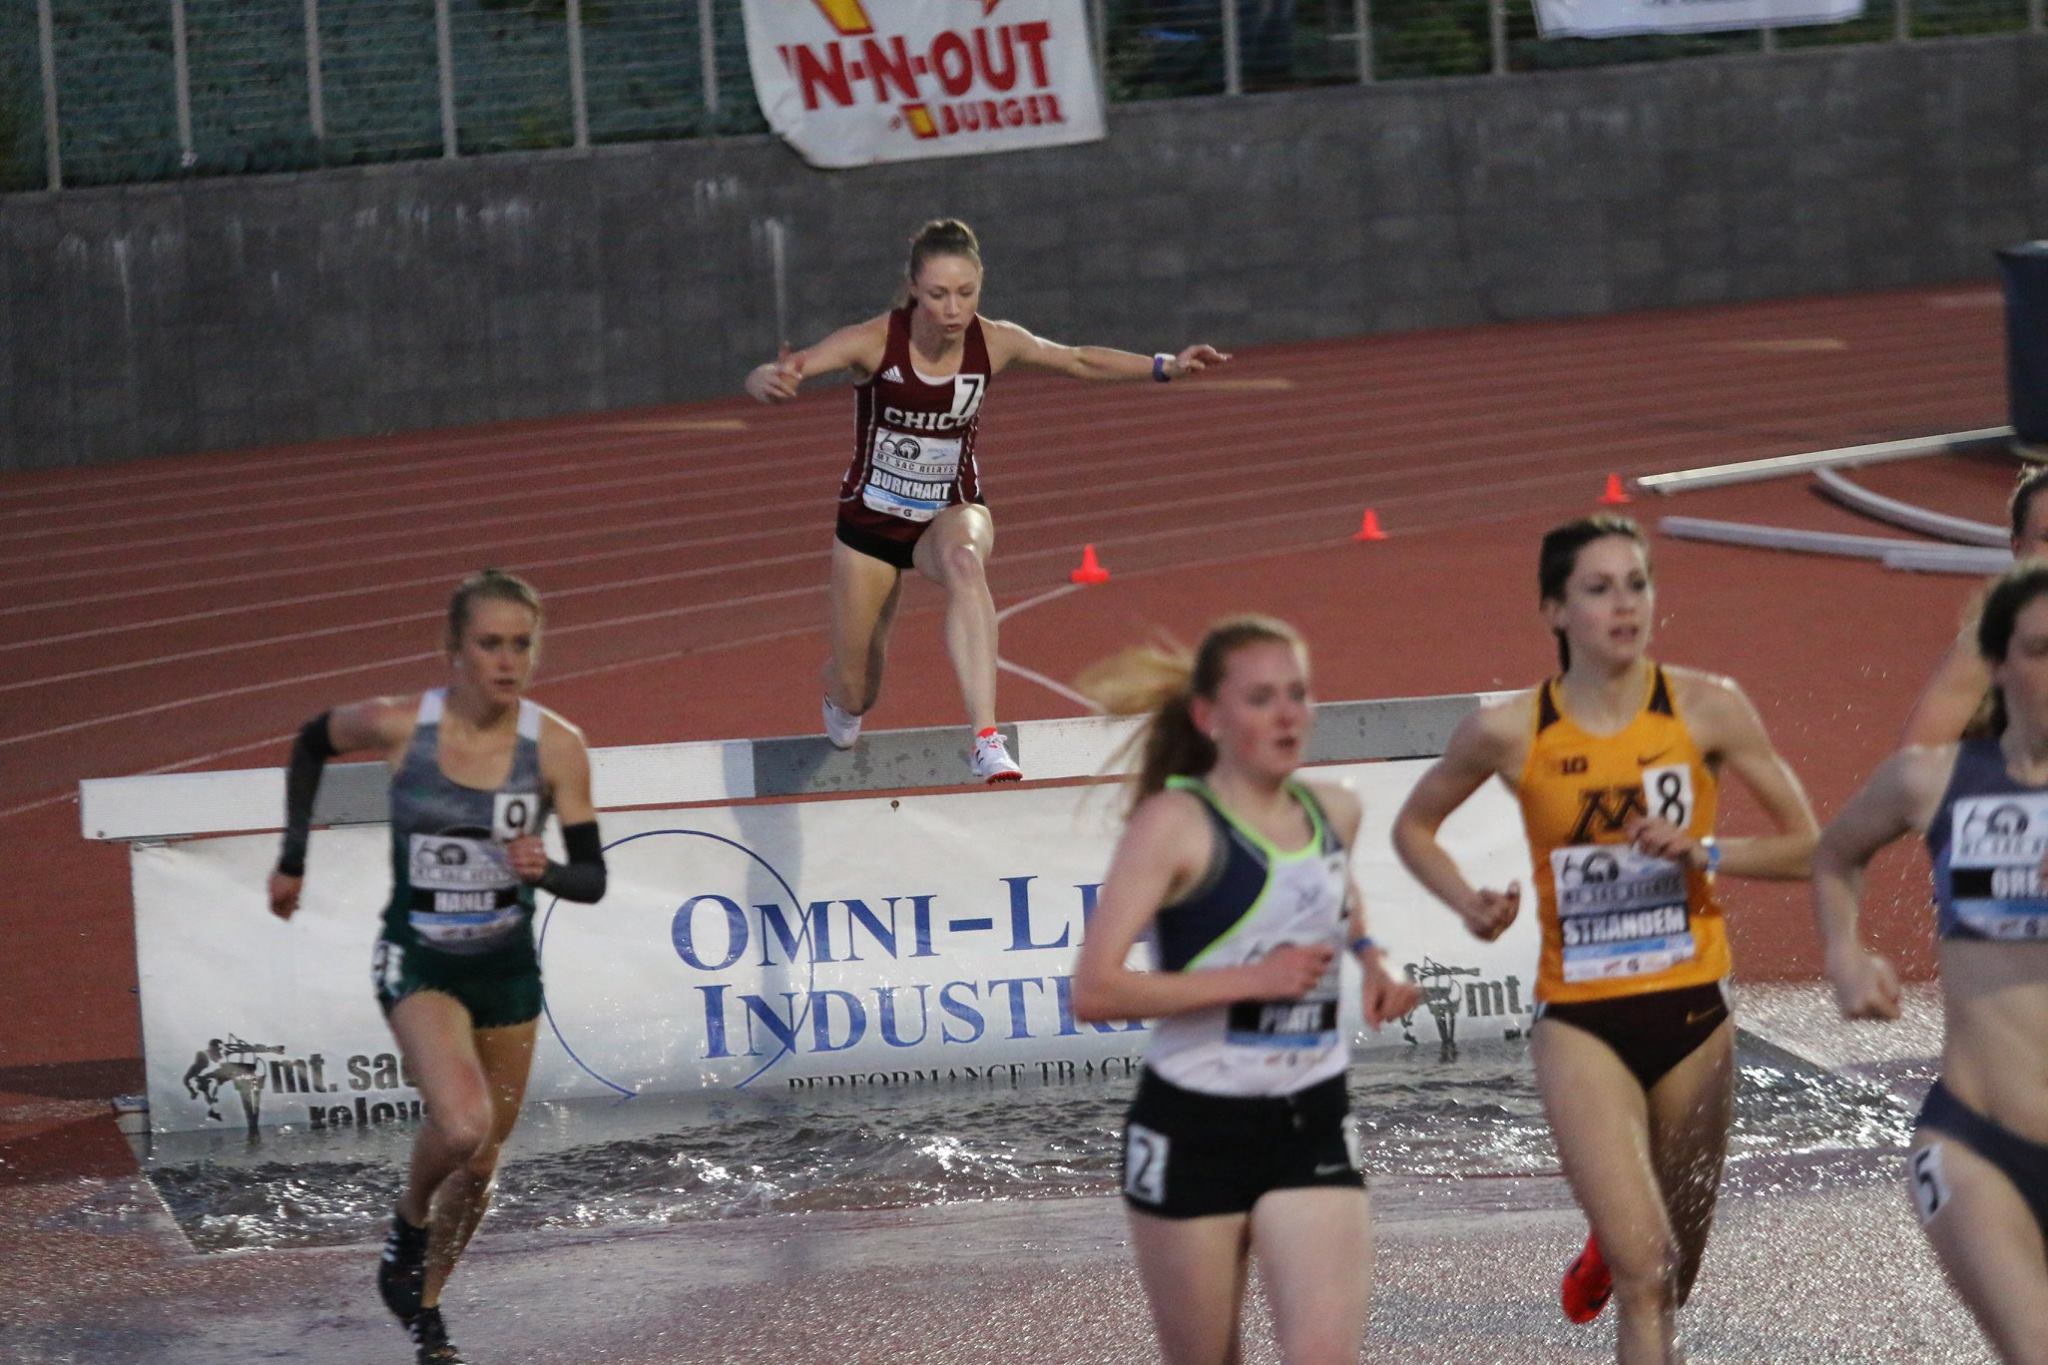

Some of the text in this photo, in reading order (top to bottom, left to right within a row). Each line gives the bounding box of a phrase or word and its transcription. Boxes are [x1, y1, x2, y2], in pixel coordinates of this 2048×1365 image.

[941, 93, 1067, 136] BURGER
[962, 379, 980, 417] 7
[871, 469, 951, 500] BURKHART
[1656, 771, 1685, 829] 8
[671, 875, 1151, 971] OMNI-LI
[1465, 975, 1533, 1018] mt.
[268, 1052, 339, 1094] mt.
[1135, 1135, 1158, 1198] 2
